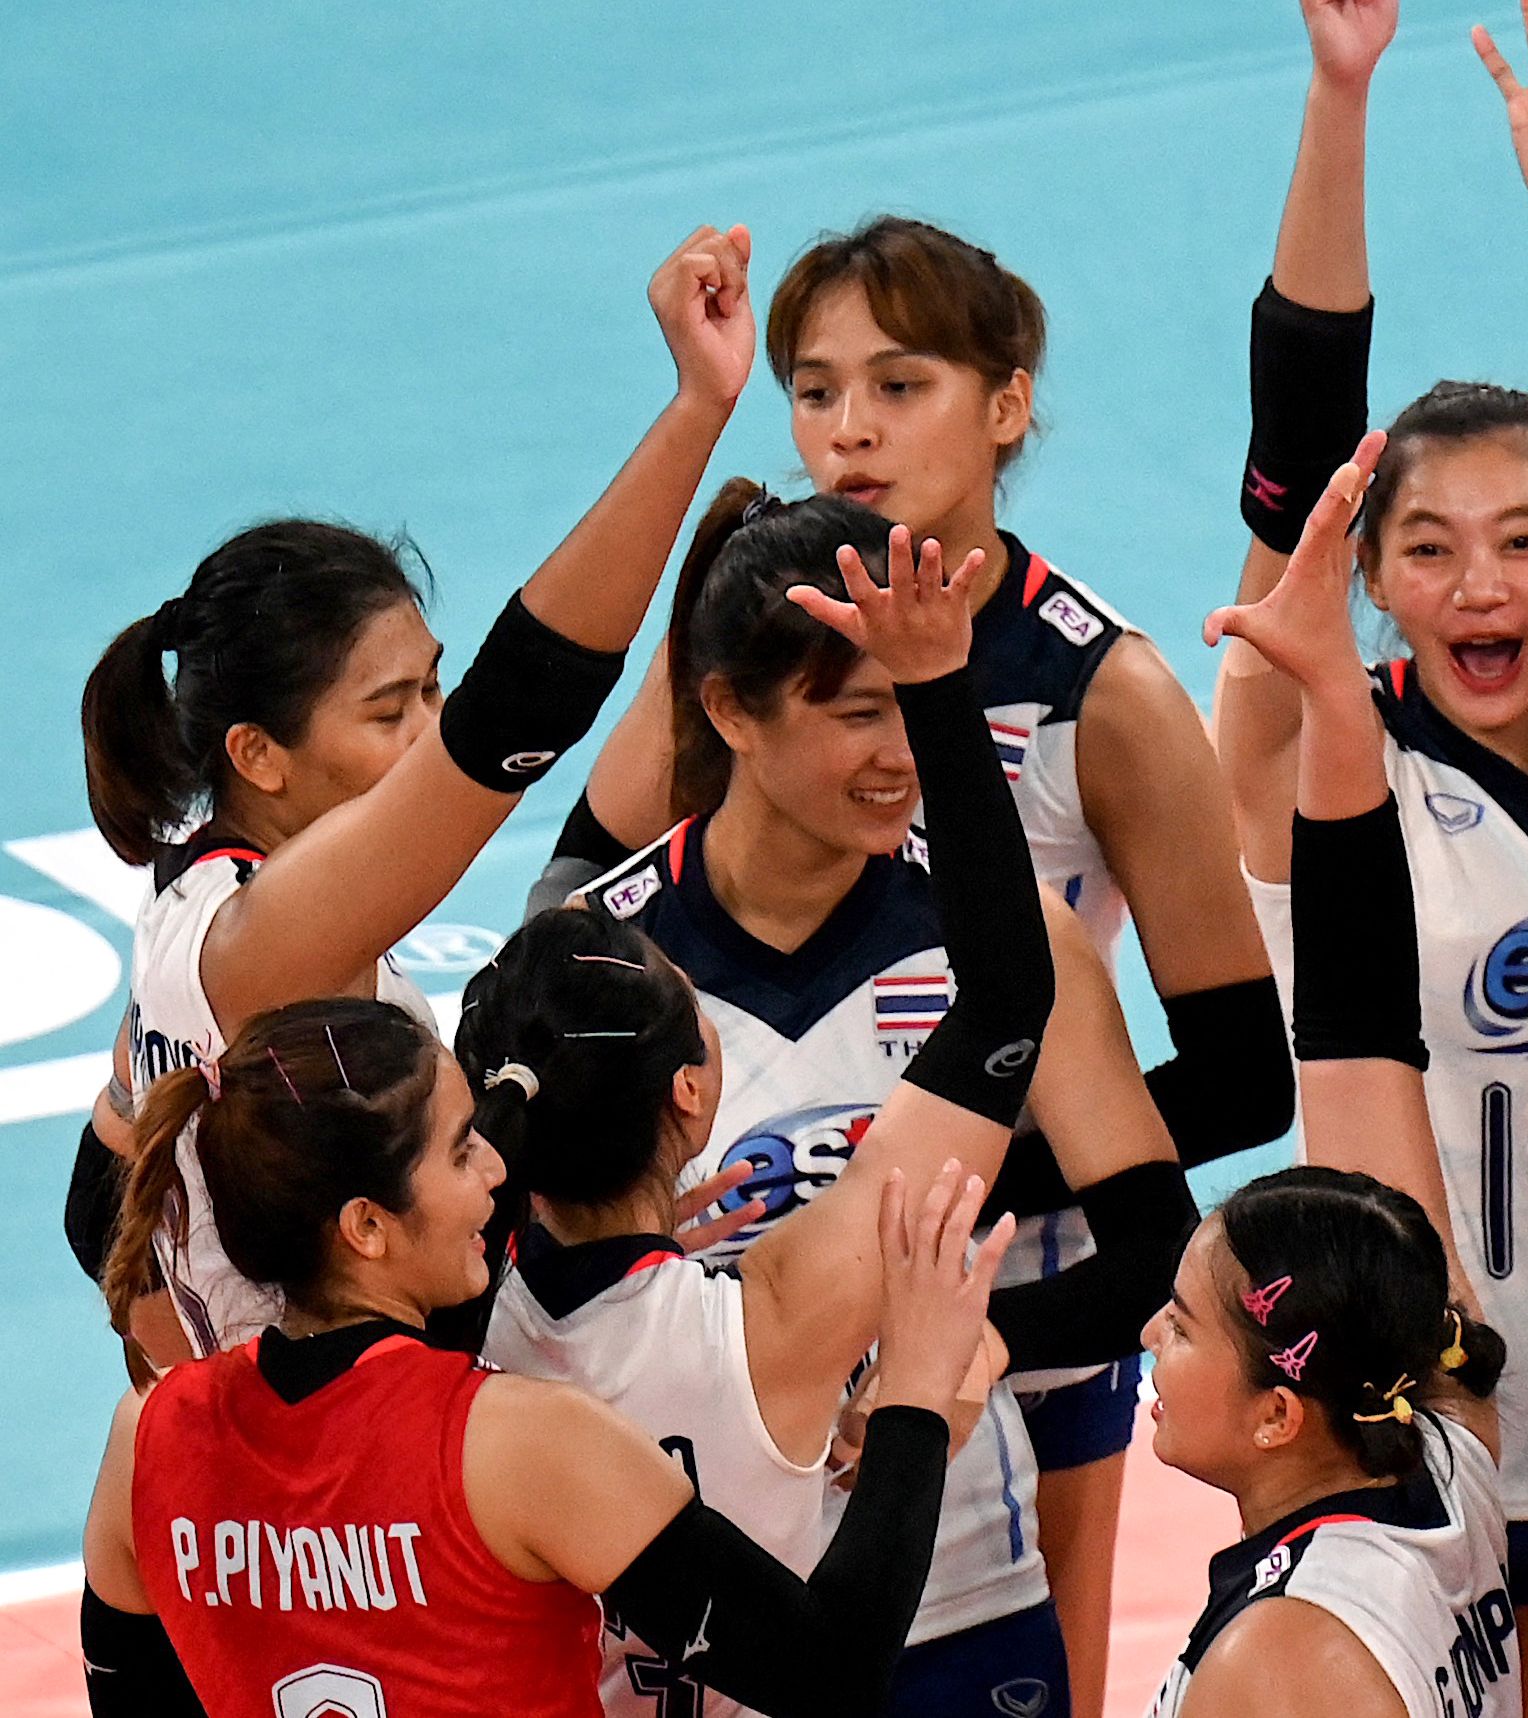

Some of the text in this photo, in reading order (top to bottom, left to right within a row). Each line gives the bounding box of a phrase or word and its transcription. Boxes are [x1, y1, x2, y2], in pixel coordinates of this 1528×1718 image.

[1048, 599, 1089, 637] PEA
[879, 1040, 928, 1057] TH
[171, 1516, 428, 1612] P.PIYANUT
